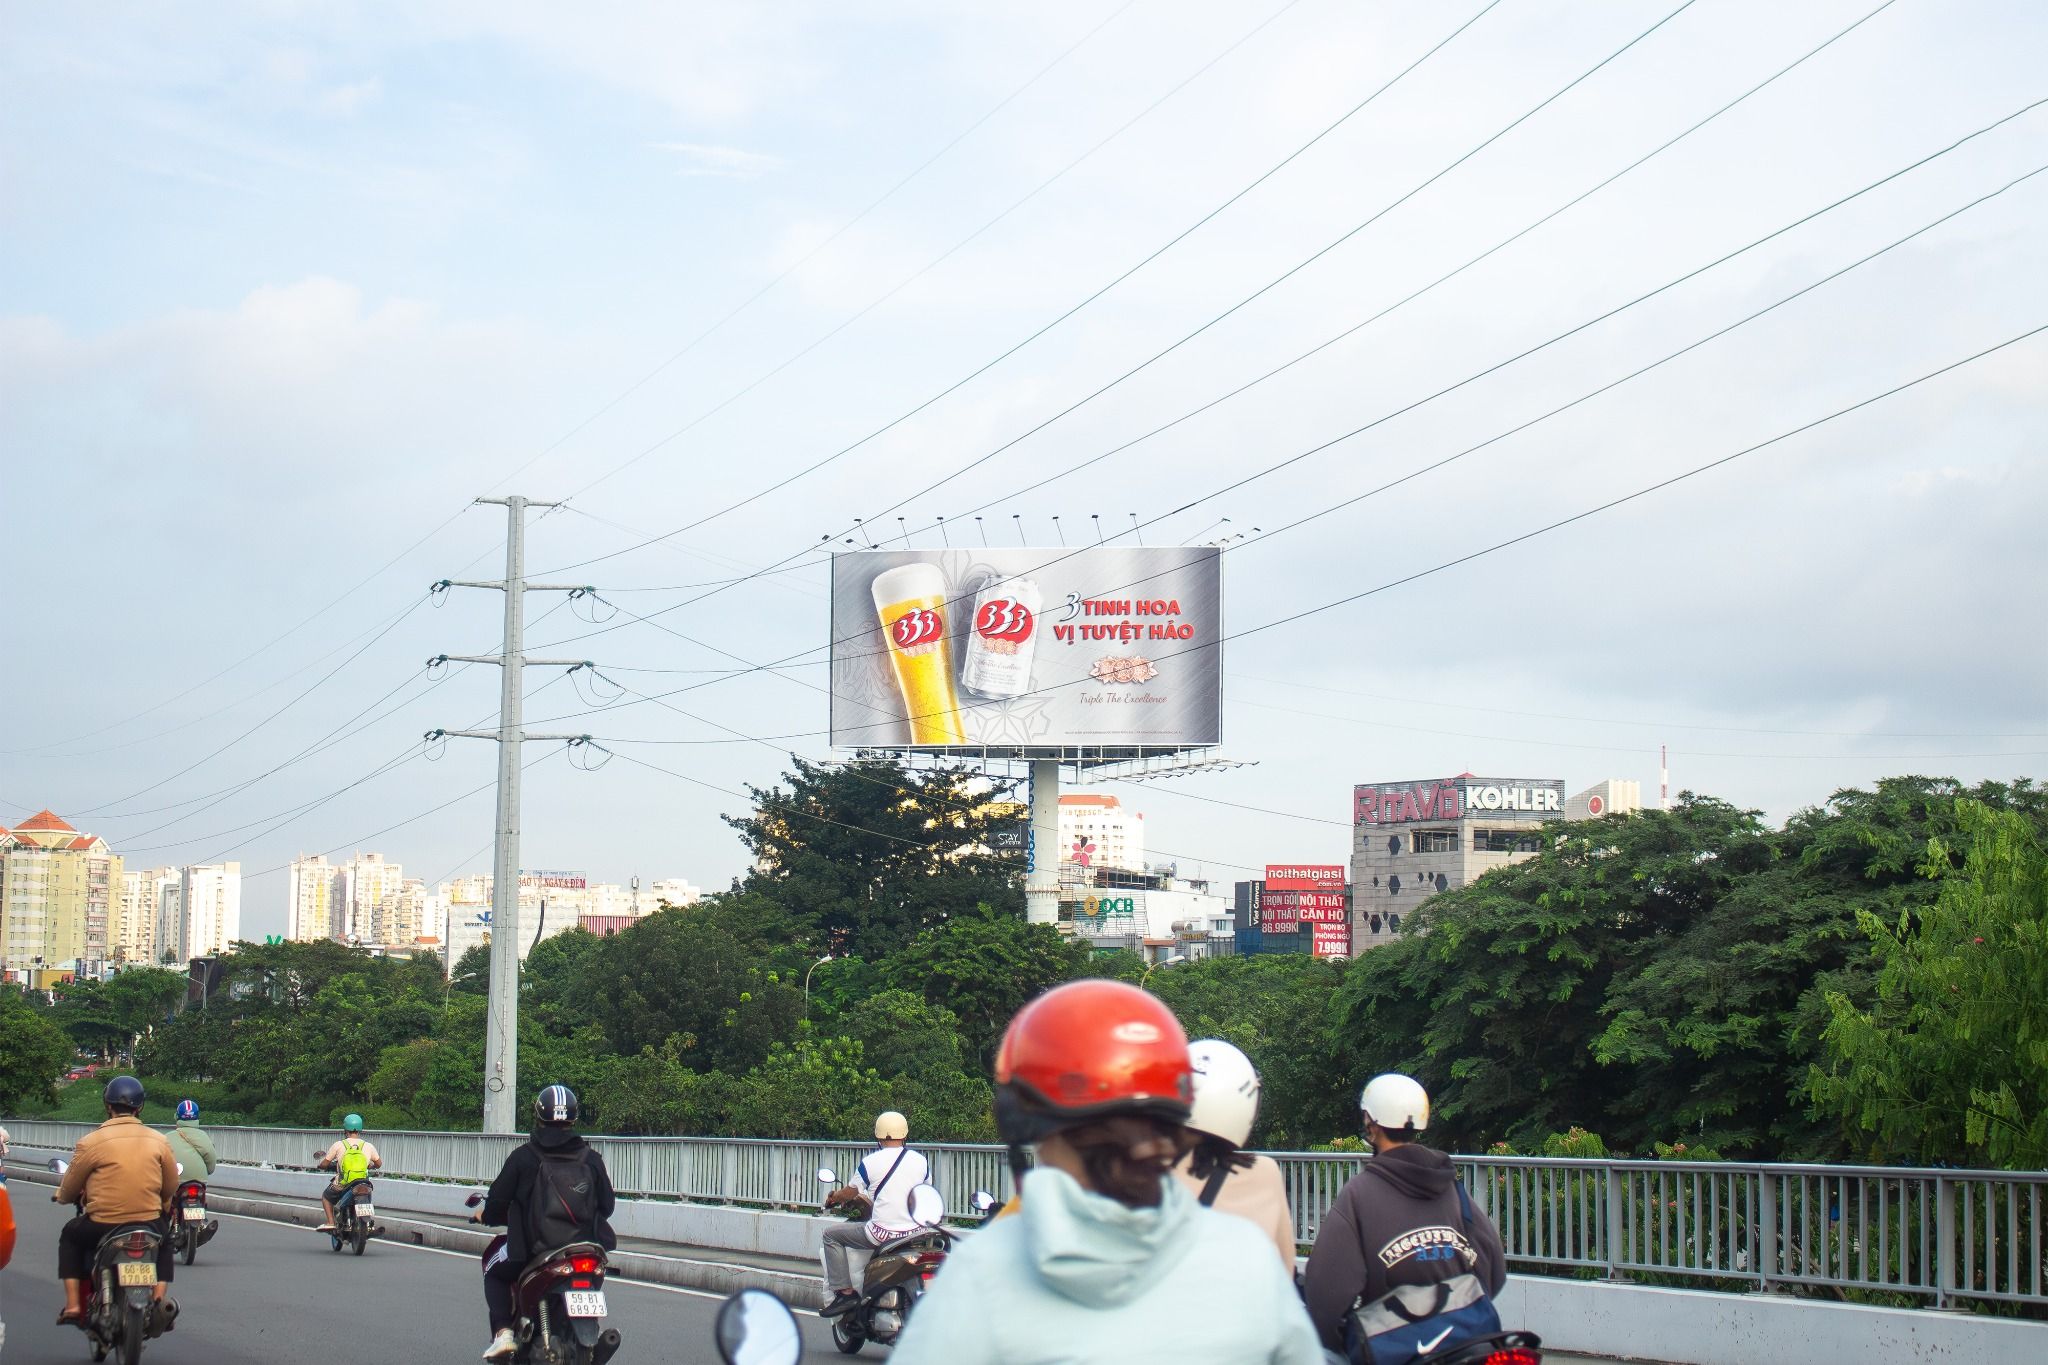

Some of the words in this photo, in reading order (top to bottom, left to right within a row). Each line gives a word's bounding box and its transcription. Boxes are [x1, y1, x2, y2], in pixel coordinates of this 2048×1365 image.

[1059, 591, 1081, 622] 3
[1082, 600, 1131, 616] TINH
[1136, 600, 1181, 616] HOA
[979, 596, 1027, 635] 333
[898, 607, 935, 645] 333
[1053, 624, 1075, 646] VỊ
[1079, 620, 1144, 645] TUYỆT
[1080, 692, 1103, 706] Triple
[1107, 692, 1122, 704] The
[1124, 692, 1168, 704] Excellence
[1467, 785, 1561, 811] KOHLER
[1268, 869, 1342, 881] noithatgiasi
[1101, 897, 1134, 913] OCB
[1318, 893, 1344, 906] THẤT
[1276, 906, 1297, 920] THẤT
[1300, 907, 1324, 920] CĂN
[1327, 908, 1345, 922] HỘ
[1262, 922, 1297, 933] 86.999K
[1317, 942, 1347, 954] 7.999K
[571, 1293, 598, 1303] 59-B1
[570, 1304, 605, 1315] 689.23
